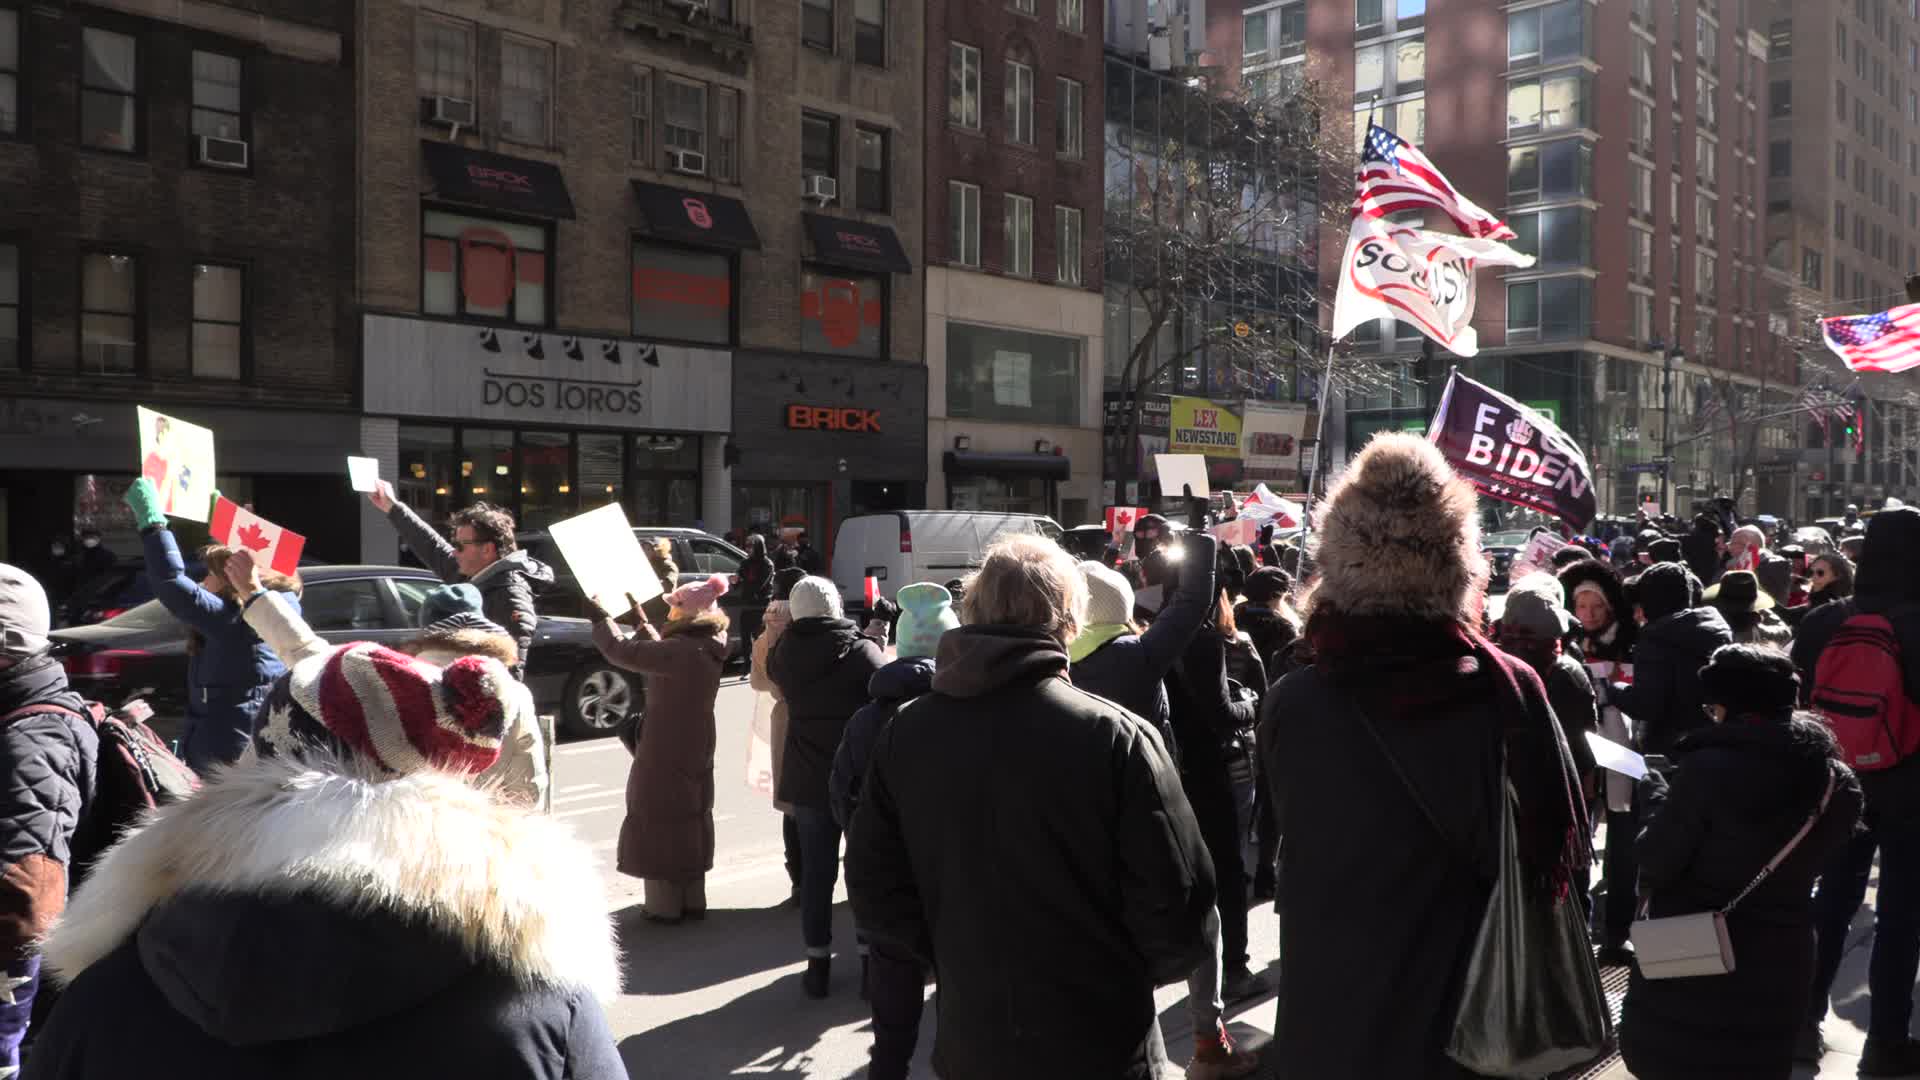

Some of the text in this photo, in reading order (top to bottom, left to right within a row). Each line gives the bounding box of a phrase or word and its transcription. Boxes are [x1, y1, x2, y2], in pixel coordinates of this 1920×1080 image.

[483, 379, 545, 408] DOS
[788, 405, 881, 432] BRICK
[1193, 408, 1218, 428] LEX
[1175, 429, 1237, 446] NEWSSTAND
[1464, 433, 1588, 499] BIDEN
